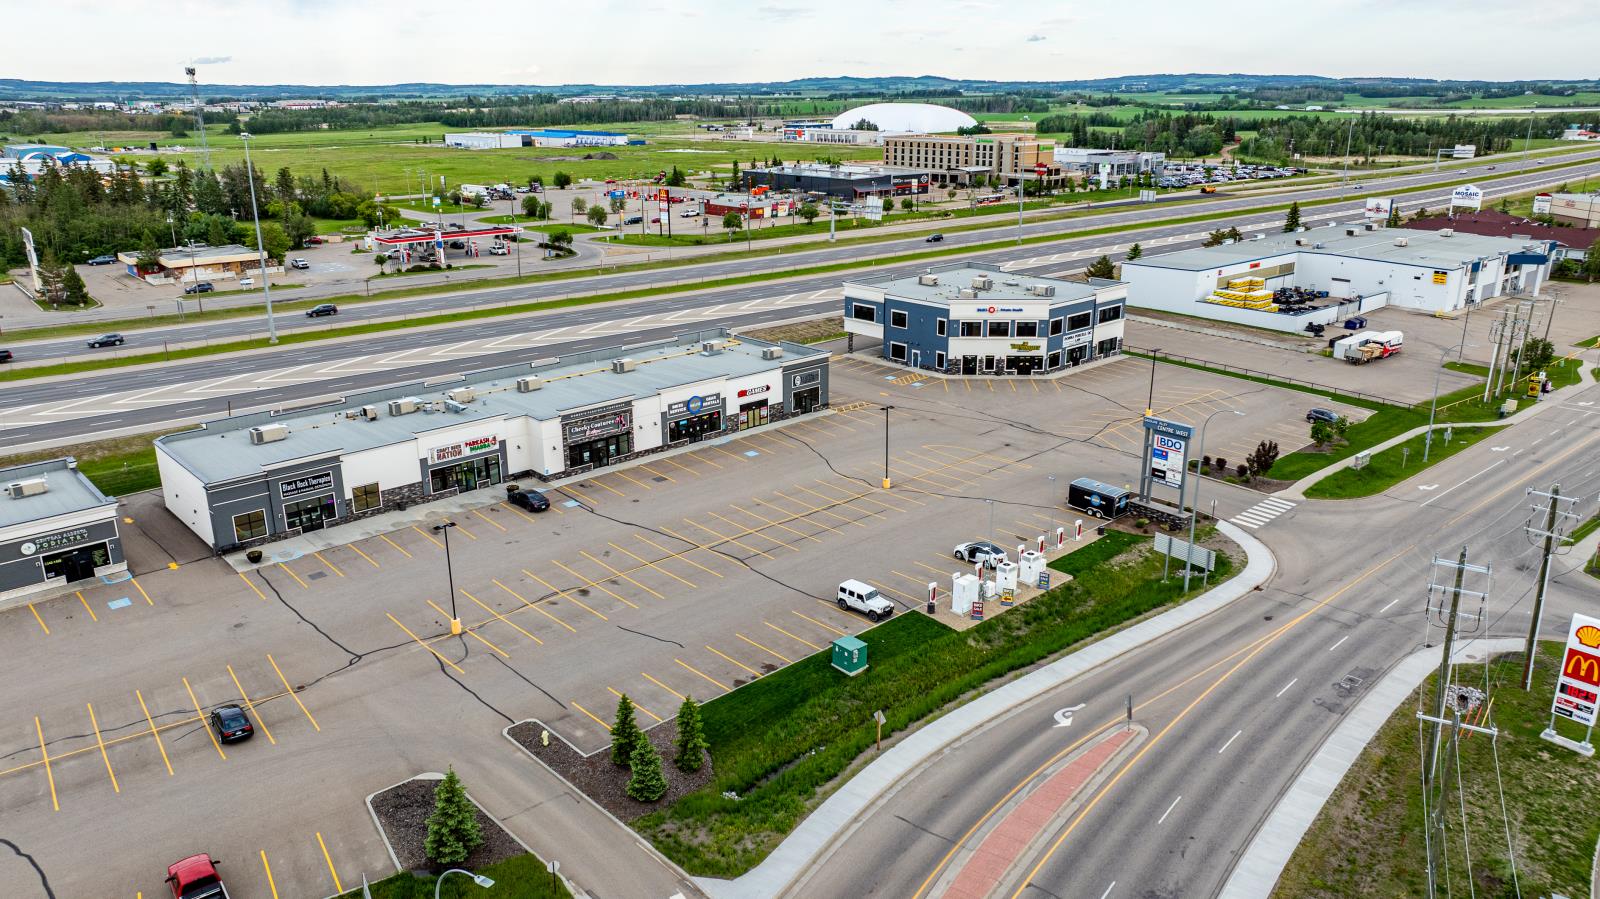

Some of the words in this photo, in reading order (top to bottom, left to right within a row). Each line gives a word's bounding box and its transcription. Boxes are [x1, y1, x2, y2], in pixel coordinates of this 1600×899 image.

[464, 437, 490, 448] PARKASH
[1159, 437, 1182, 450] BDO
[436, 449, 463, 461] NATION
[282, 483, 296, 491] Black
[296, 480, 308, 488] Rock
[309, 476, 331, 486] Therapies
[36, 533, 88, 549] PODIATRY
